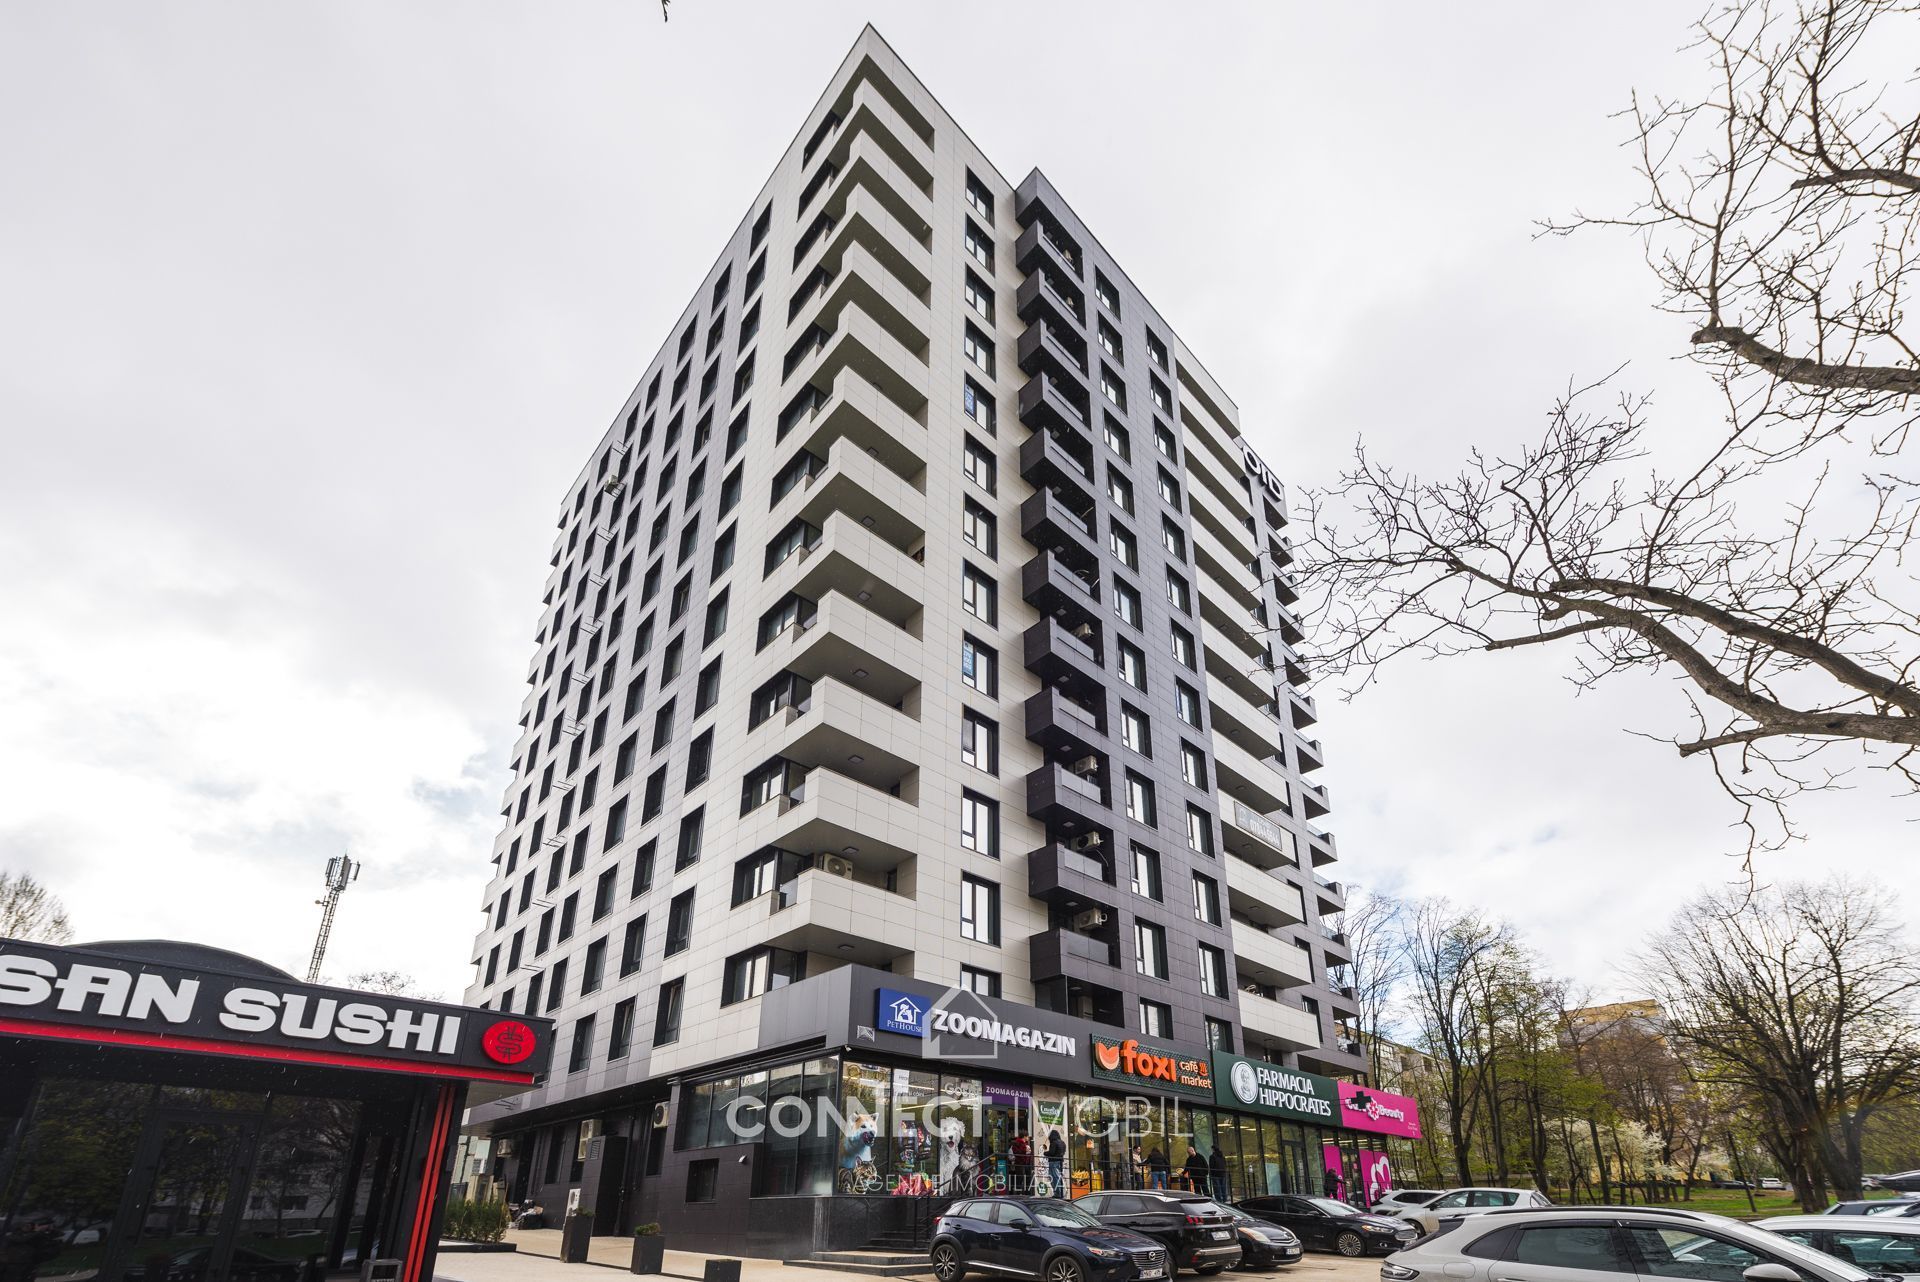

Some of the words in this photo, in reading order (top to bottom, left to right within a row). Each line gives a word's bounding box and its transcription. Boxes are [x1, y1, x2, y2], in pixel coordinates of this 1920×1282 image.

[0, 954, 201, 1024] SAN
[218, 986, 462, 1055] SUSHI
[932, 1008, 1076, 1057] ZOOMAGAZIN
[1179, 1060, 1199, 1073] café
[985, 1086, 1030, 1099] ZOOMAGAZIN
[1181, 1074, 1213, 1089] market
[1256, 1067, 1315, 1096] FARMACIA
[1258, 1087, 1332, 1117] HIPPOCRATES
[1378, 1104, 1405, 1123] Beauty
